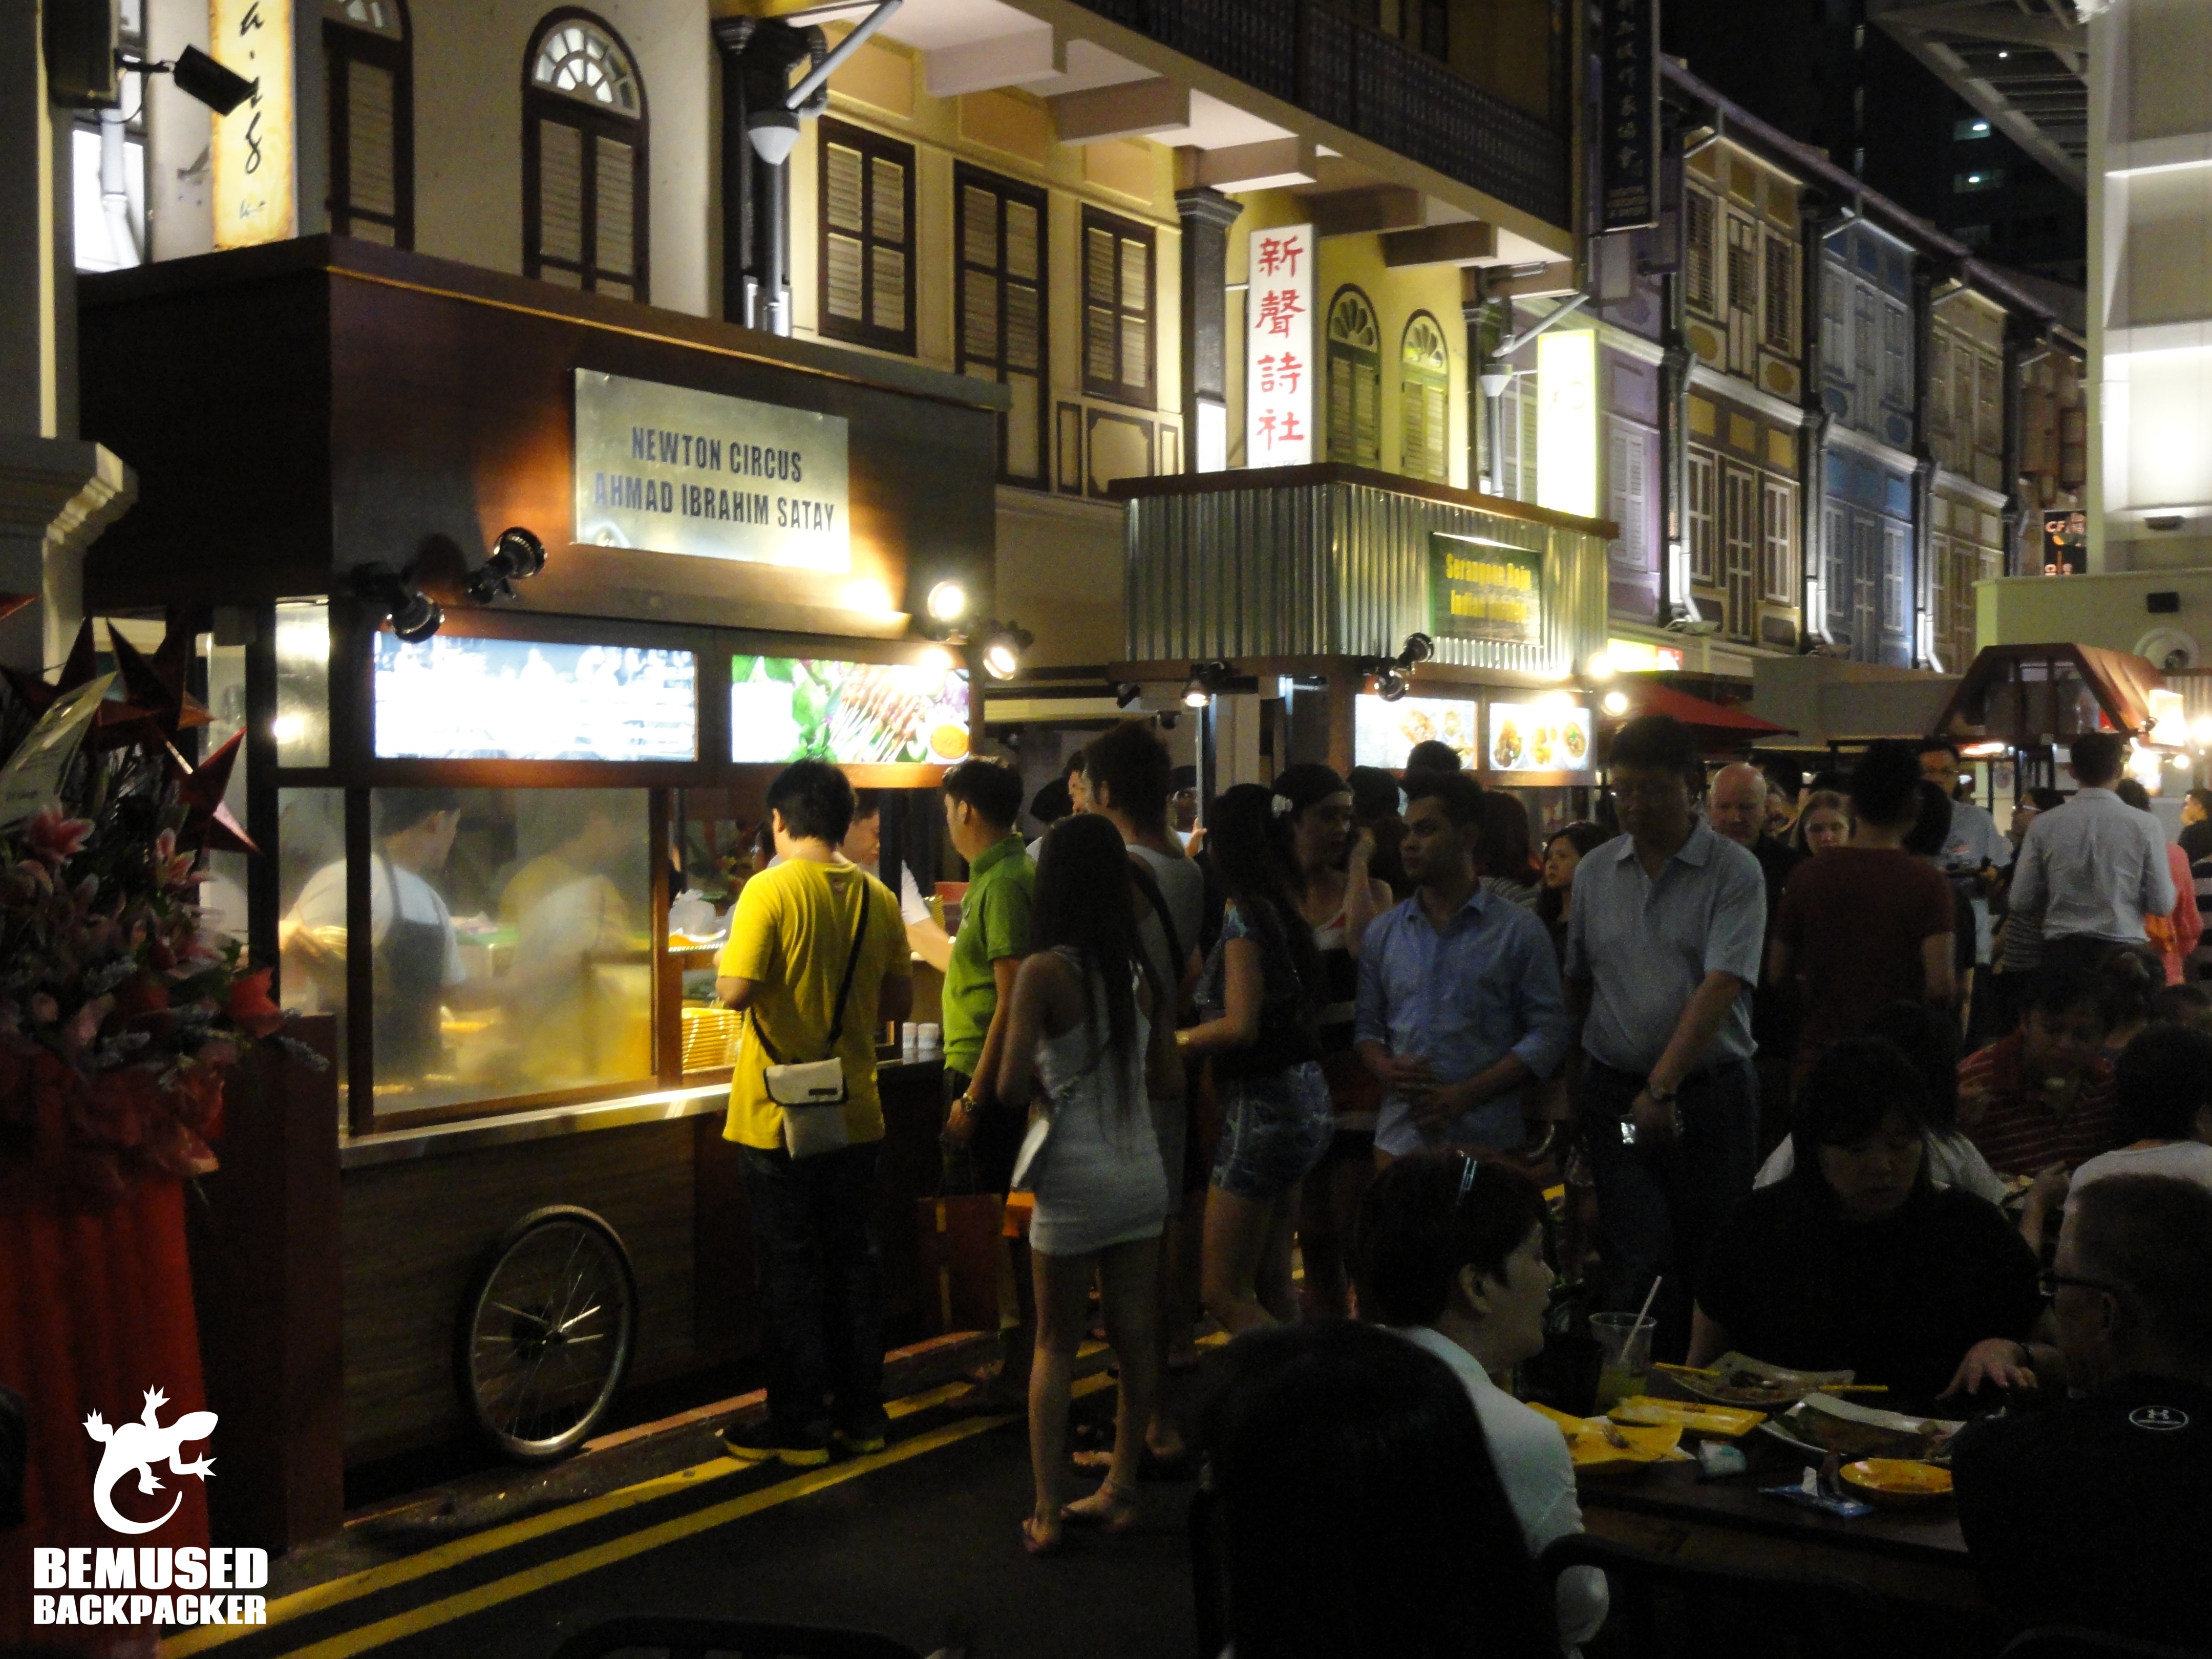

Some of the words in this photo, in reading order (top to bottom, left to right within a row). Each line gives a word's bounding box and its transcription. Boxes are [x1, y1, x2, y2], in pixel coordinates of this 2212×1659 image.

[1254, 236, 1306, 452] 新聲詩社
[631, 426, 721, 472] NEWTON
[729, 441, 802, 483] CIRCUS
[594, 472, 673, 514] AHMAD
[682, 484, 769, 525] IBRAHIM
[777, 497, 835, 532] SATAY
